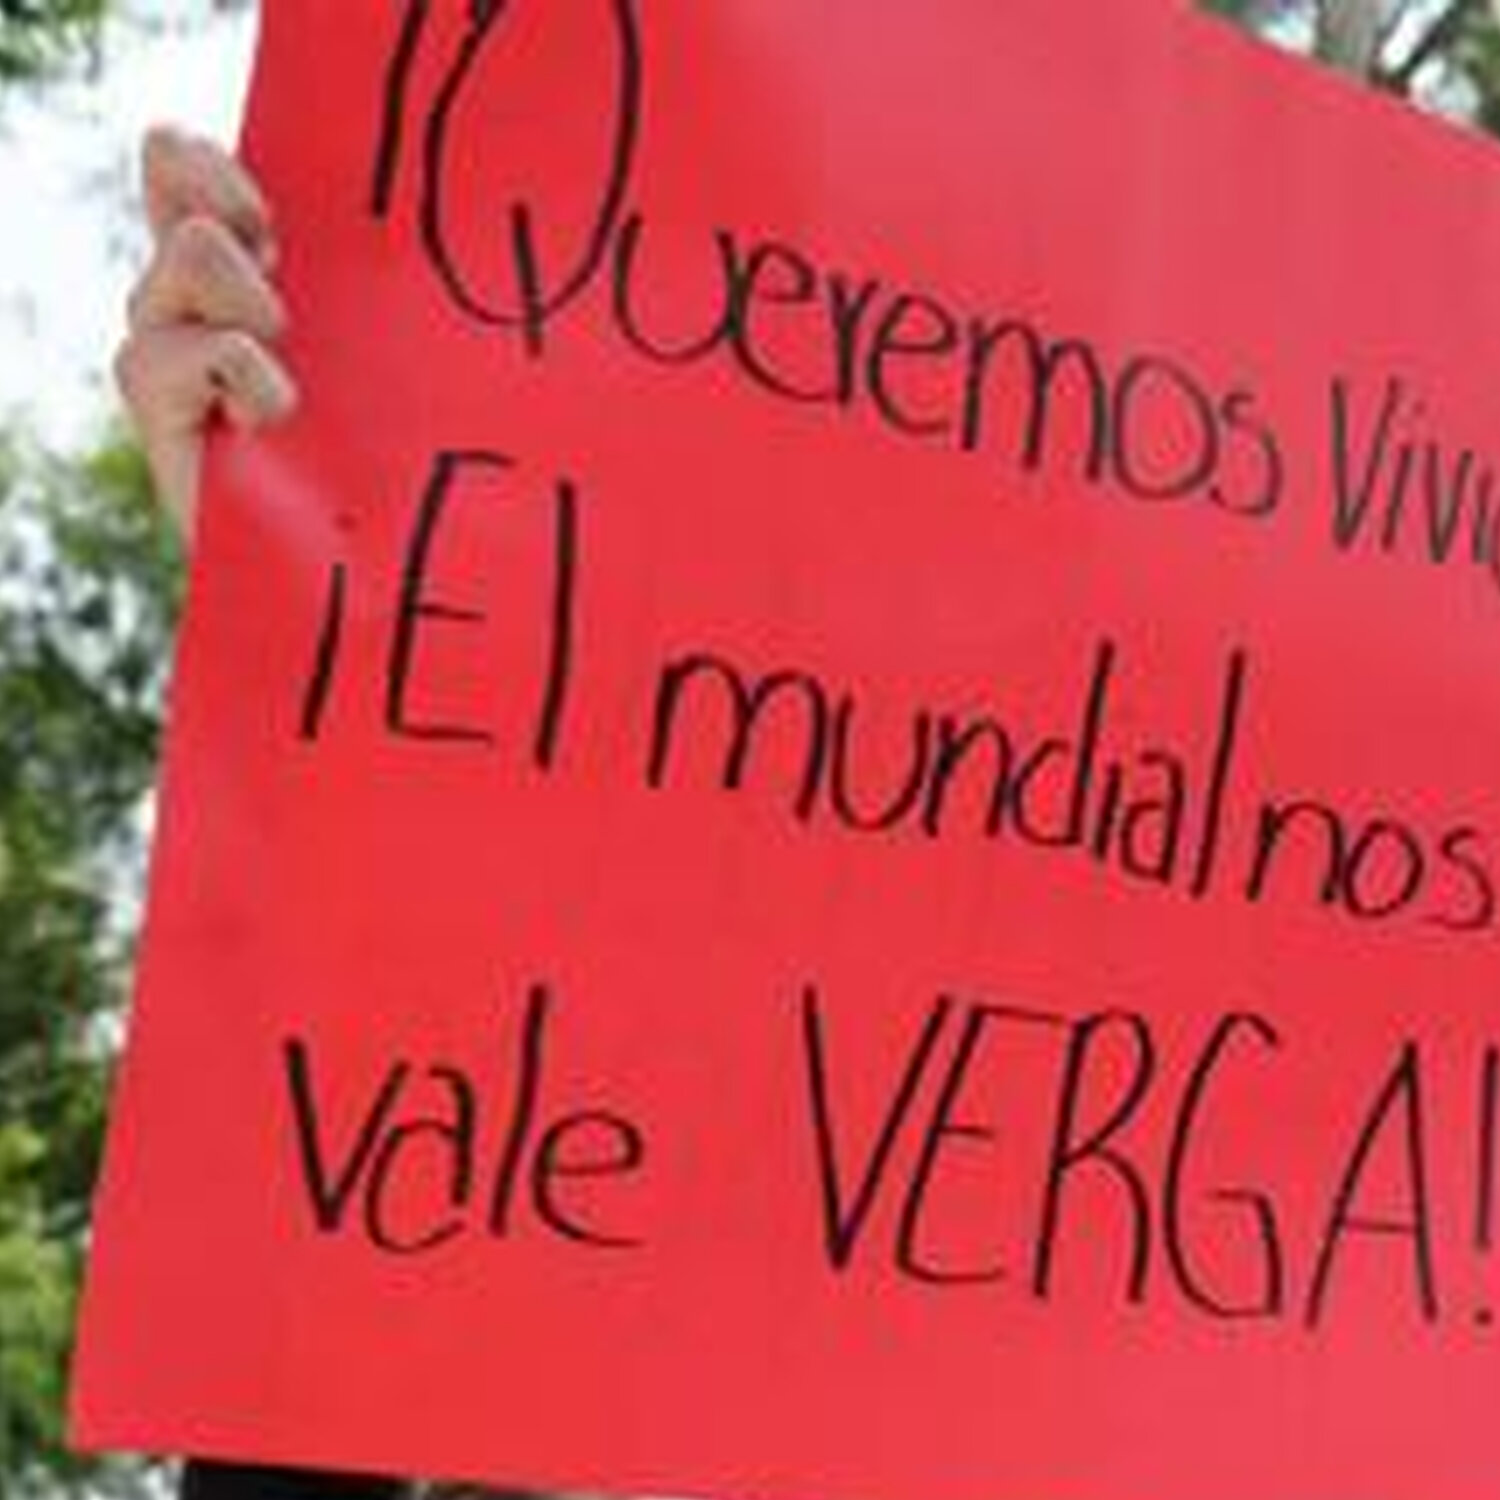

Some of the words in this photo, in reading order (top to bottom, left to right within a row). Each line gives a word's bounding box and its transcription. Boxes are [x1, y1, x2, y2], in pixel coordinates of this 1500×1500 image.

[645, 640, 1245, 900] mundial
[1246, 800, 1495, 930] nos
[284, 984, 645, 1254] vale
